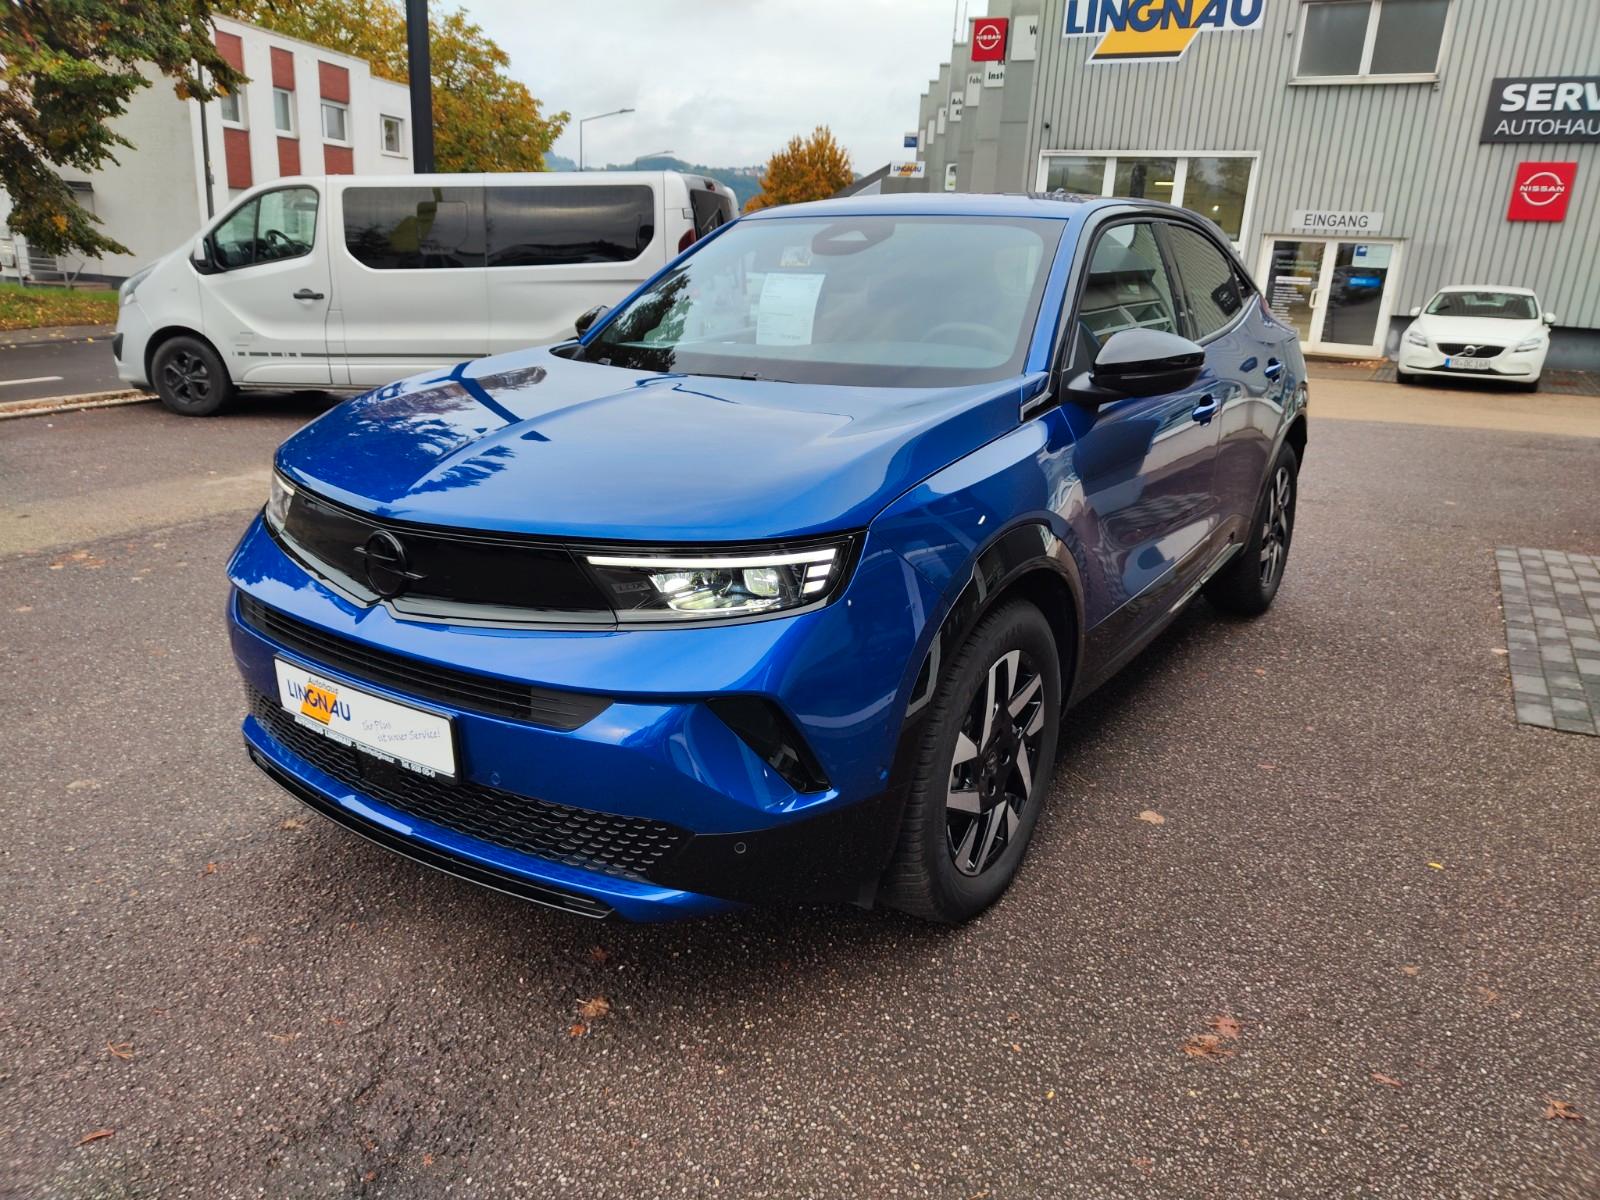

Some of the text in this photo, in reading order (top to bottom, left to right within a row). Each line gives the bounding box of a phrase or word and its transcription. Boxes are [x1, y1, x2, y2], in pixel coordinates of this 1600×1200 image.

[1066, 0, 1264, 34] LINGNAU
[1520, 184, 1565, 192] NISSAN
[1303, 213, 1369, 228] EINGANG
[287, 679, 351, 721] LINGNAU
